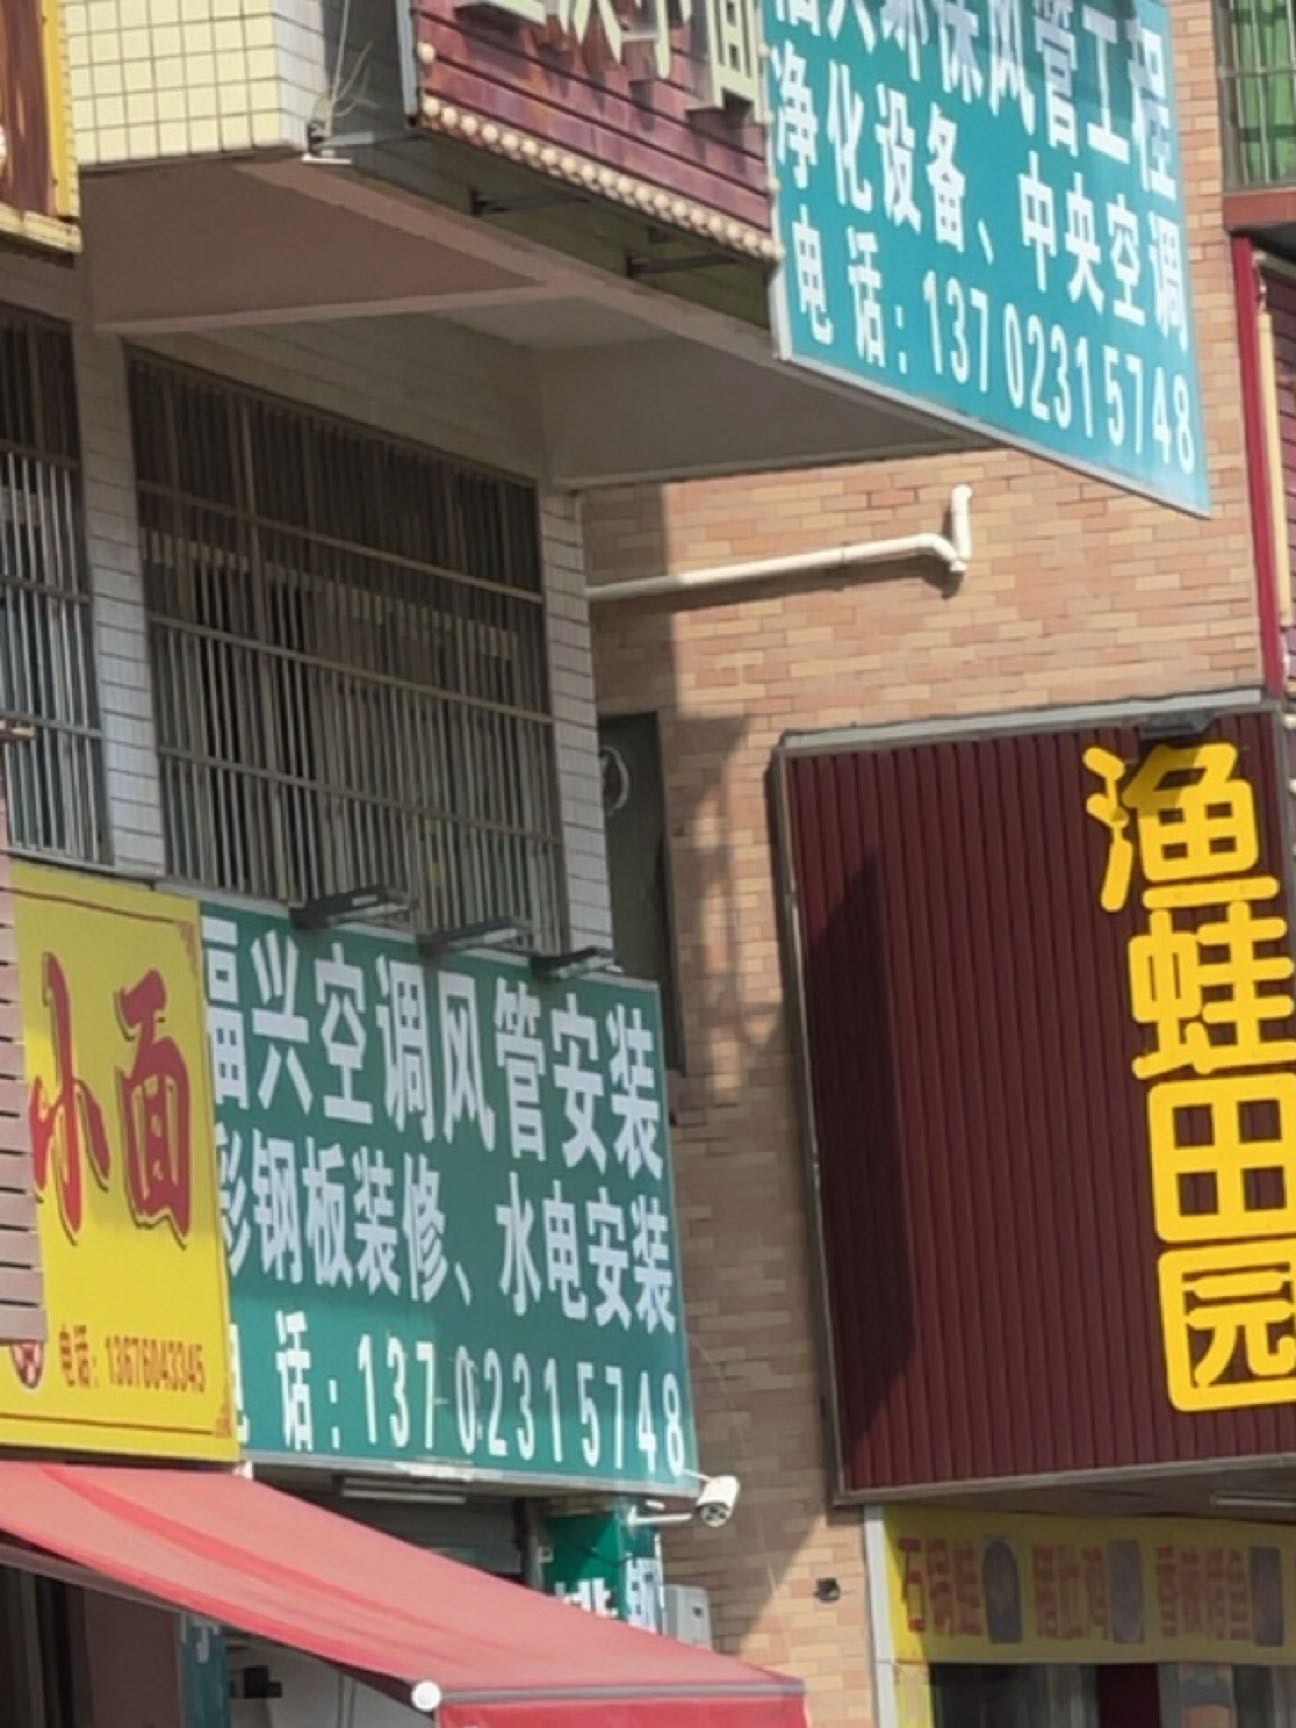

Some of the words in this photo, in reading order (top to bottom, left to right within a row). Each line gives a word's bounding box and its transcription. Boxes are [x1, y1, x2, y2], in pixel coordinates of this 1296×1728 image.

[770, 40, 1189, 353] 净化设备、中央空调
[29, 952, 193, 1250] 小面
